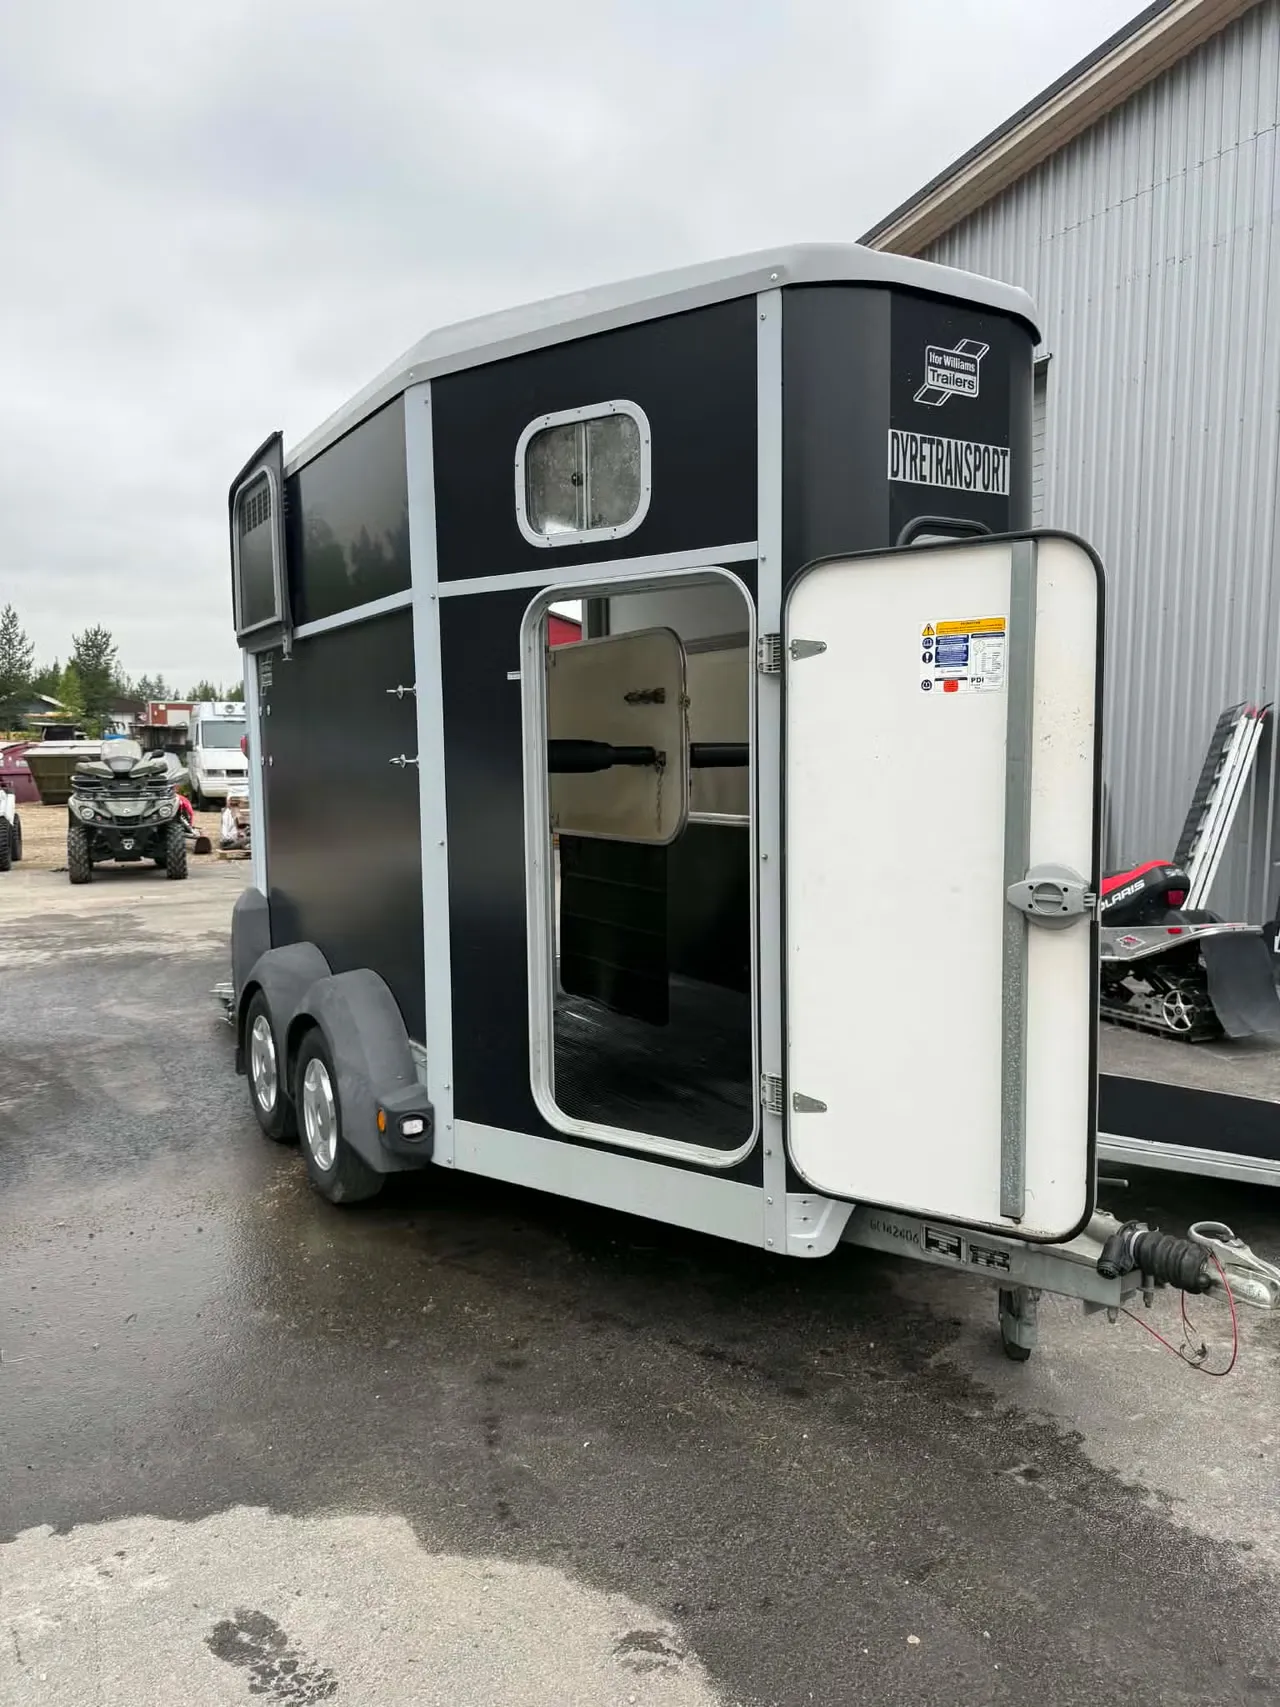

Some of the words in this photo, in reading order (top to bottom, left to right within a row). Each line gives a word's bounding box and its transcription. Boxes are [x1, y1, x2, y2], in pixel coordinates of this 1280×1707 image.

[943, 354, 975, 372] Williams
[930, 370, 974, 390] Trailers
[891, 431, 1008, 493] DYRETRANSPORT
